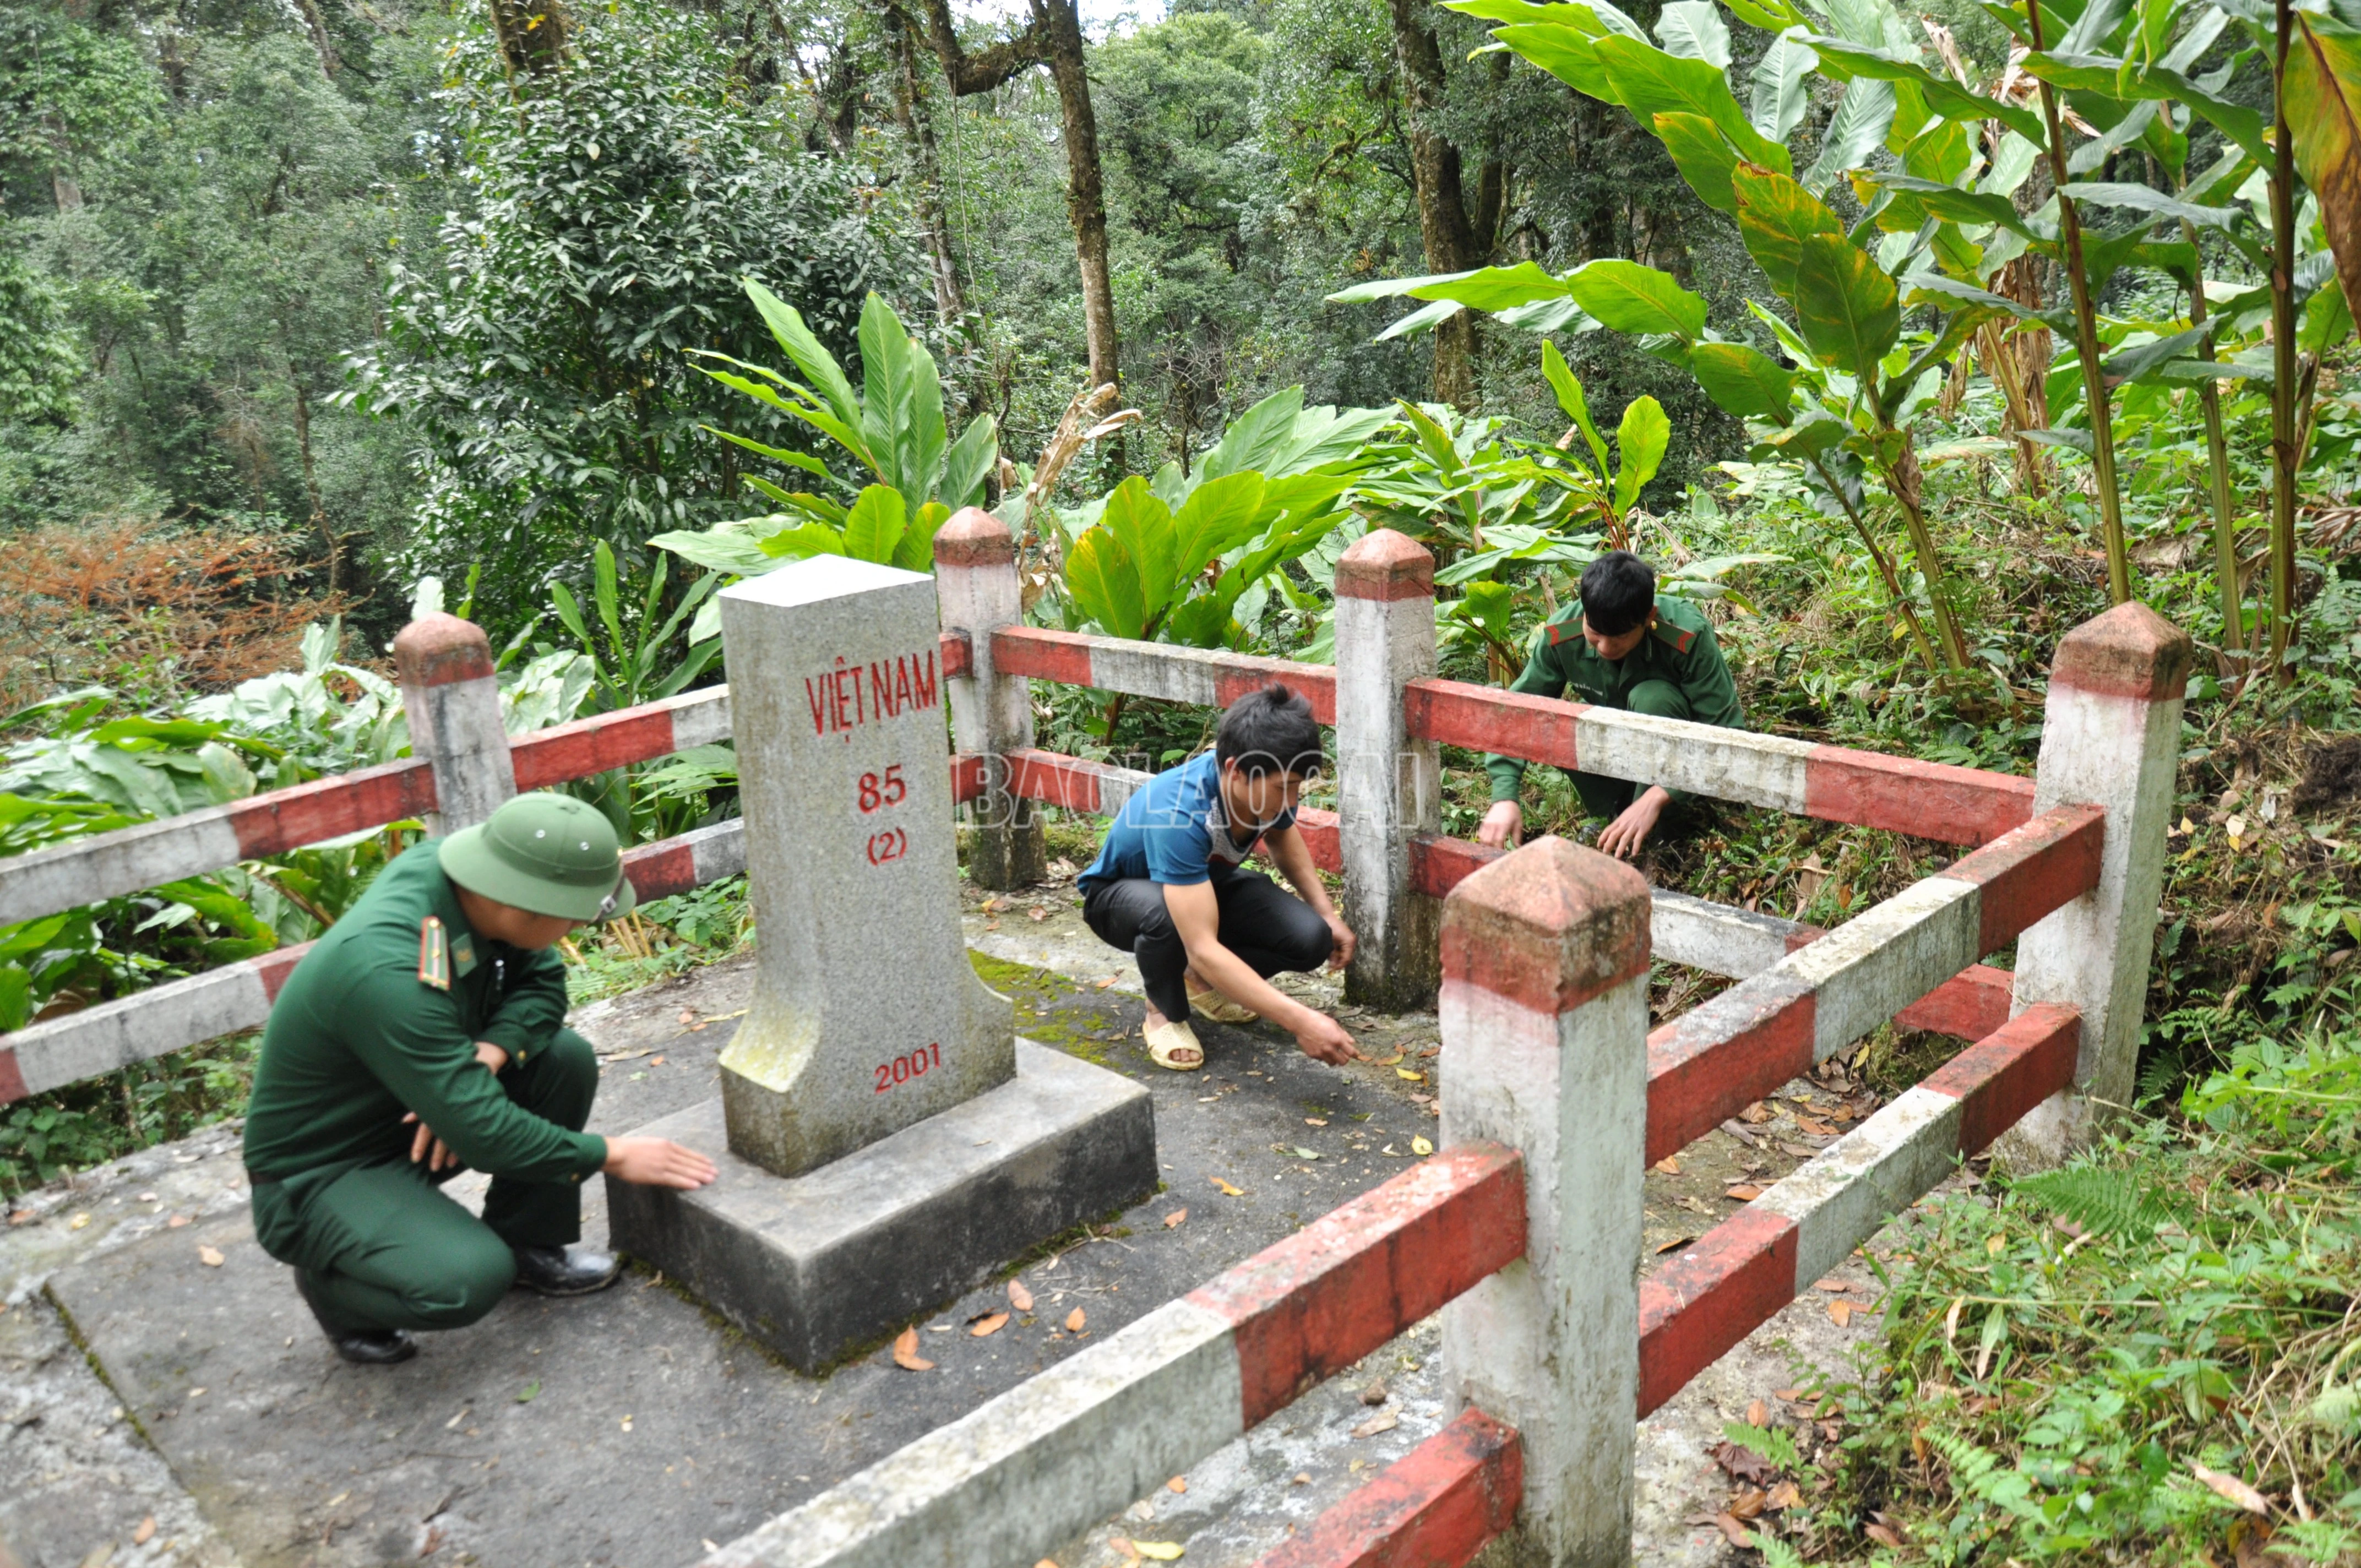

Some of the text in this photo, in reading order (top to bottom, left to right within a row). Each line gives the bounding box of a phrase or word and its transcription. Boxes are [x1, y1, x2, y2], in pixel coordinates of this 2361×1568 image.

[805, 649, 937, 743] VIỆT NAM
[858, 764, 906, 815] 85
[867, 827, 907, 867] (2)
[874, 1042, 940, 1095] 2001
